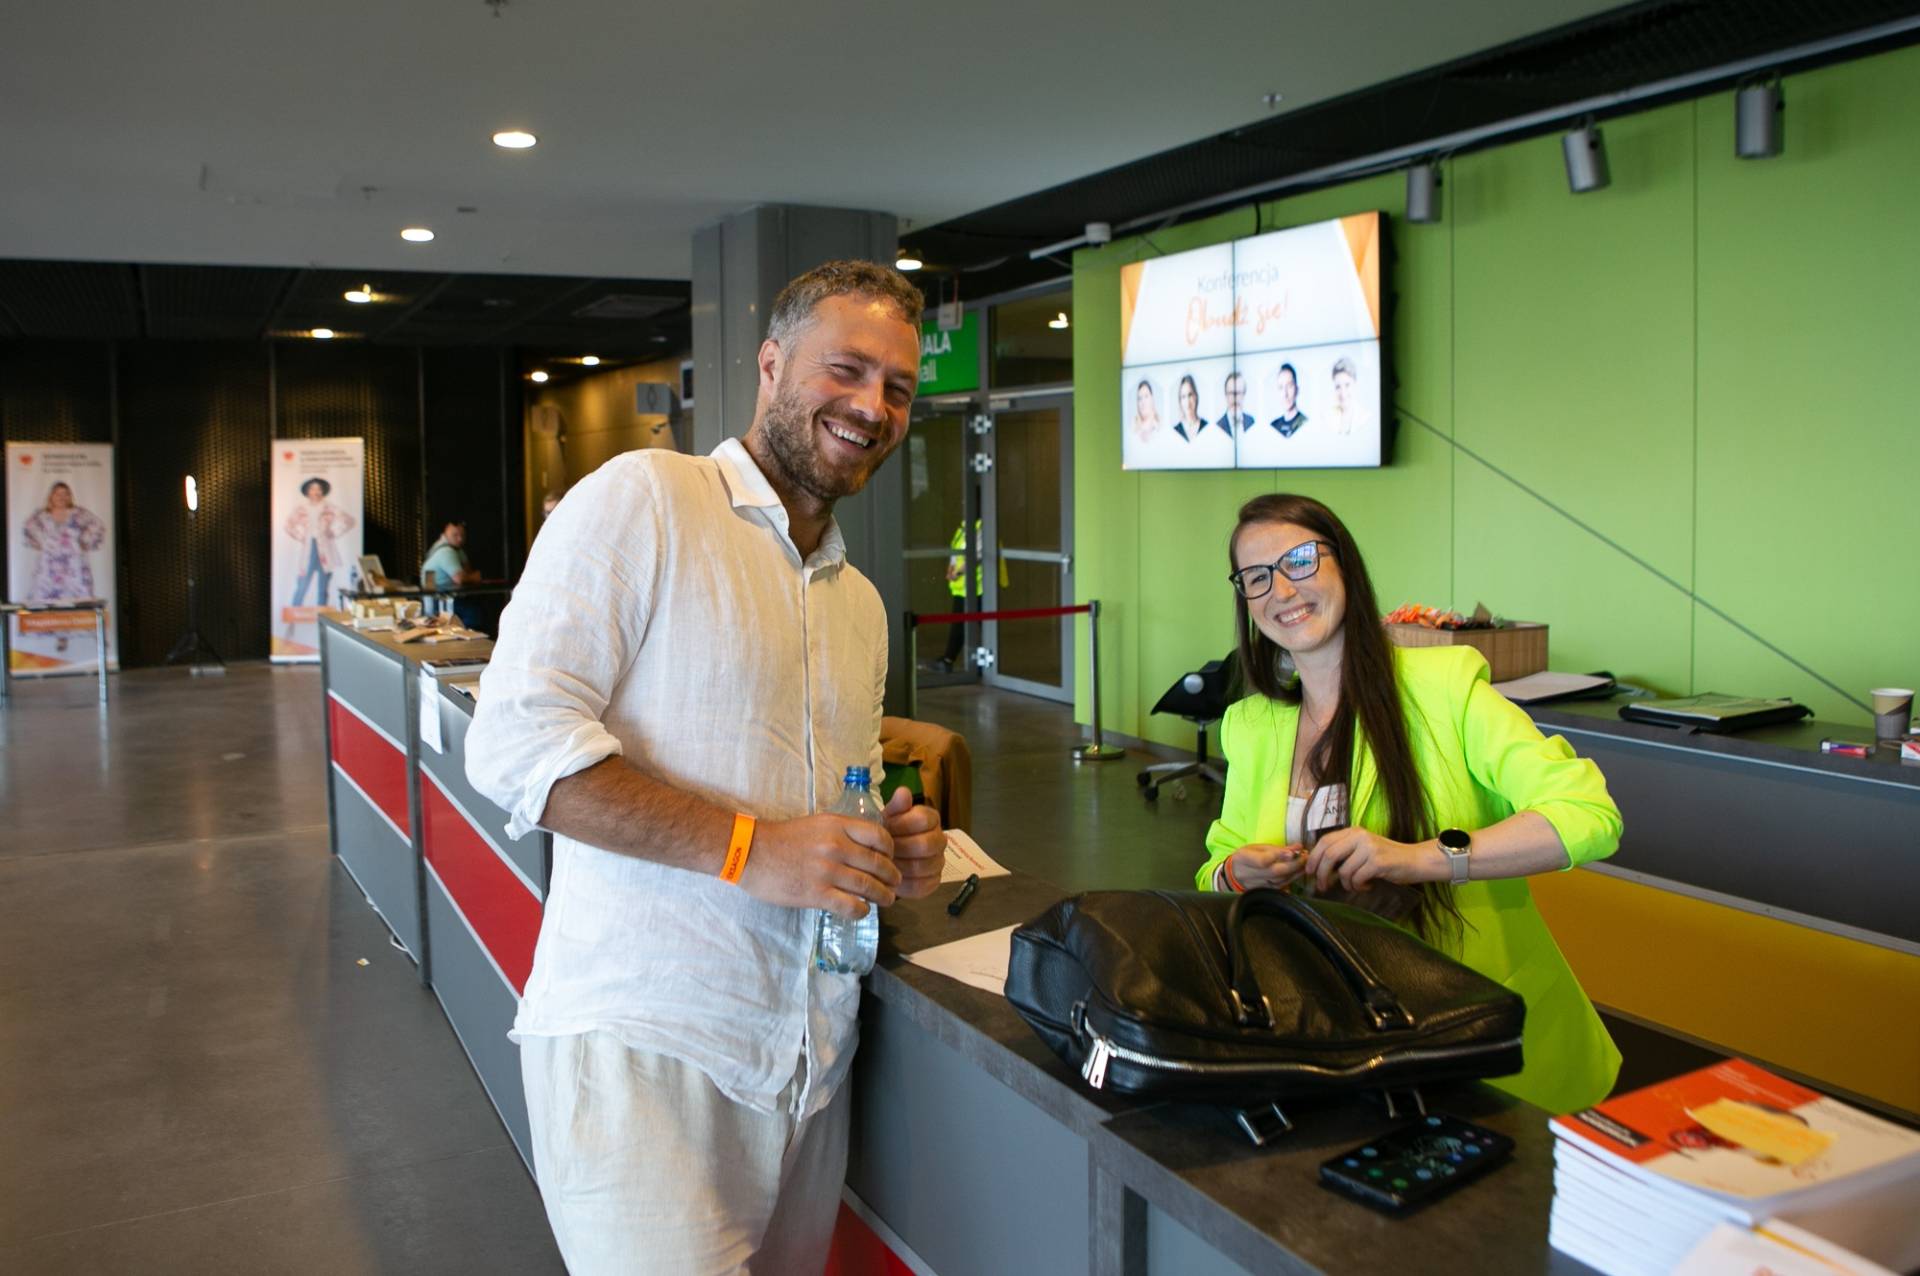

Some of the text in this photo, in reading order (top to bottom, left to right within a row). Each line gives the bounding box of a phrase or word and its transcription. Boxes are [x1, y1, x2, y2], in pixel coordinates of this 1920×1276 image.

[1197, 262, 1280, 292] Konferencja
[920, 331, 952, 356] ALA
[919, 359, 937, 382] all
